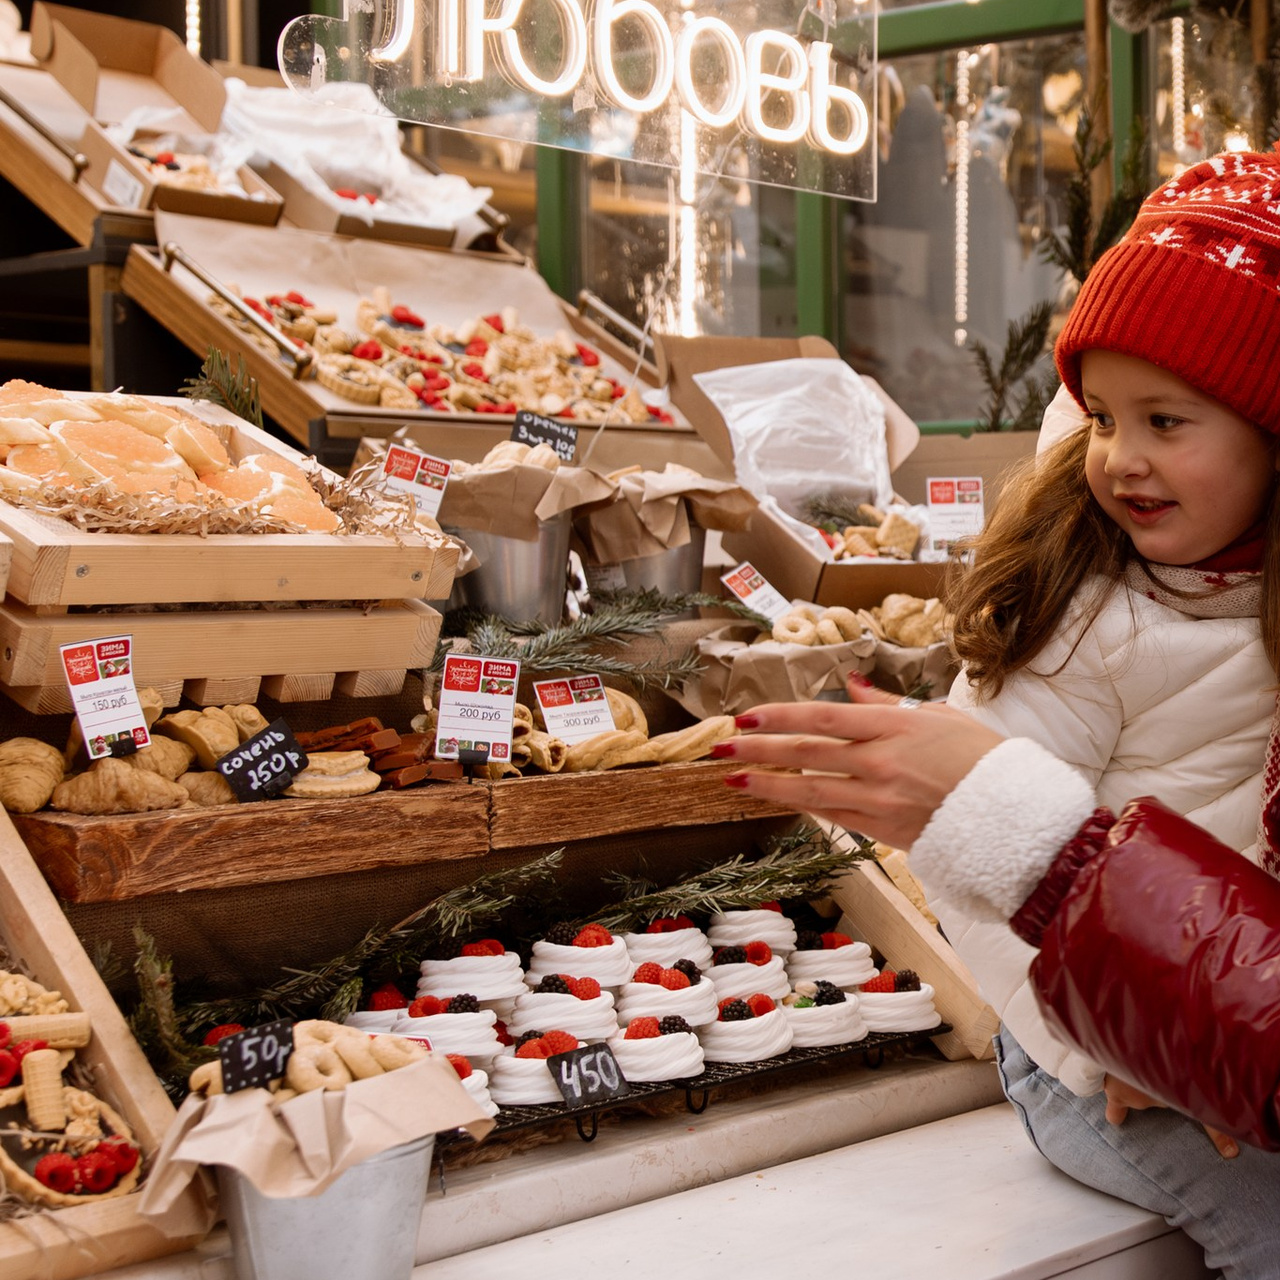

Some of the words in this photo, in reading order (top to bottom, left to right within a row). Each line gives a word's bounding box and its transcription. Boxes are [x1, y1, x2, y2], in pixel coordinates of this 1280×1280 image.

[100, 642, 125, 652] ЗИМА
[488, 664, 512, 672] ЗИМА
[92, 699, 109, 712] 150
[111, 694, 128, 710] руб
[459, 707, 480, 718] 200
[481, 710, 501, 721] руб
[563, 717, 581, 728] 300
[583, 715, 600, 725] руб
[561, 1050, 620, 1098] 450
